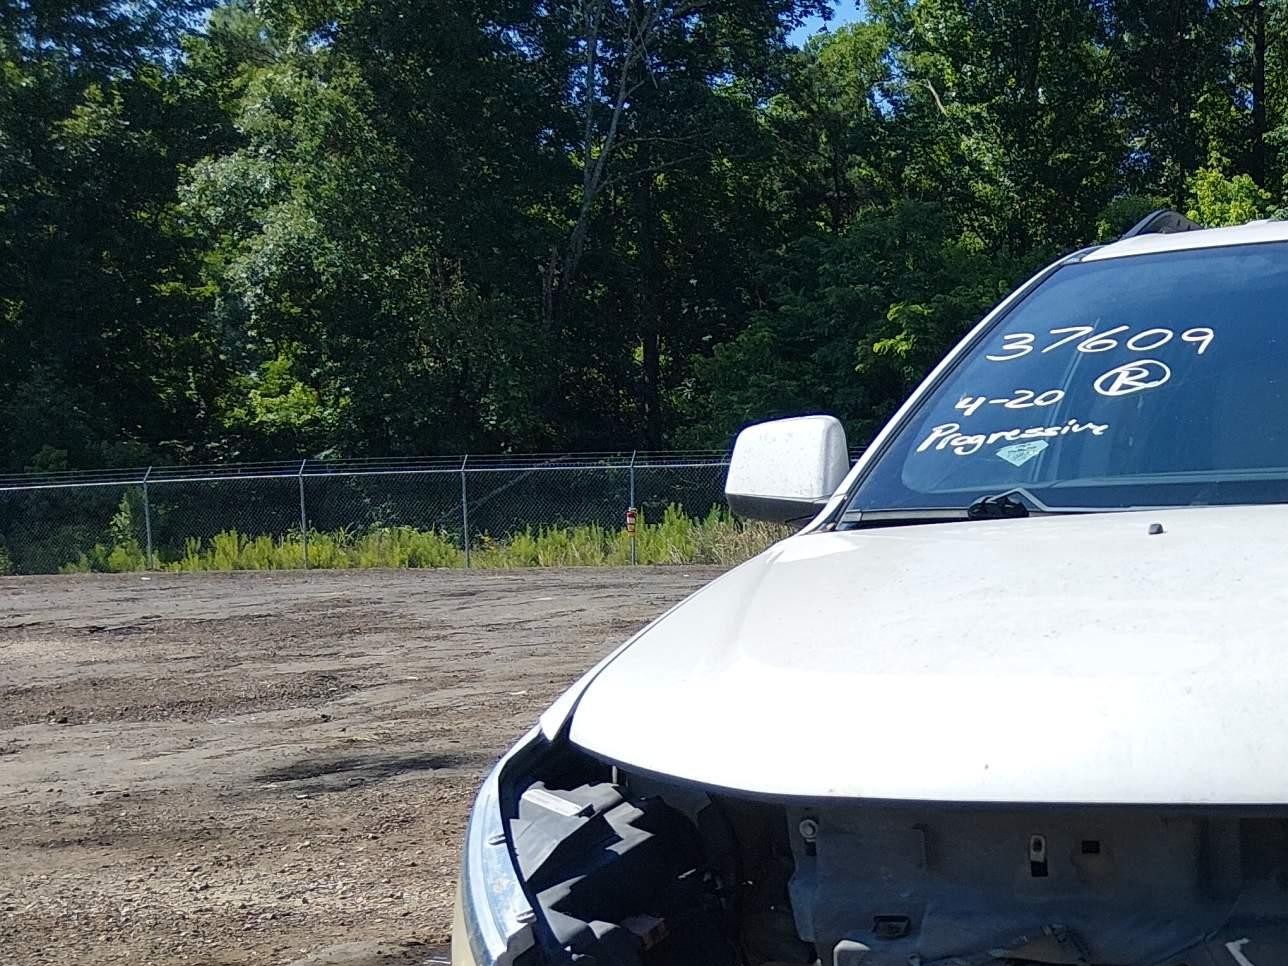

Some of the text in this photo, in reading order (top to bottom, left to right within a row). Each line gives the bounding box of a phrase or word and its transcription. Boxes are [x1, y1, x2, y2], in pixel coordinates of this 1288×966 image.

[986, 325, 1215, 361] 37609
[955, 389, 1065, 416] 4-20
[916, 419, 1109, 456] Progressive
